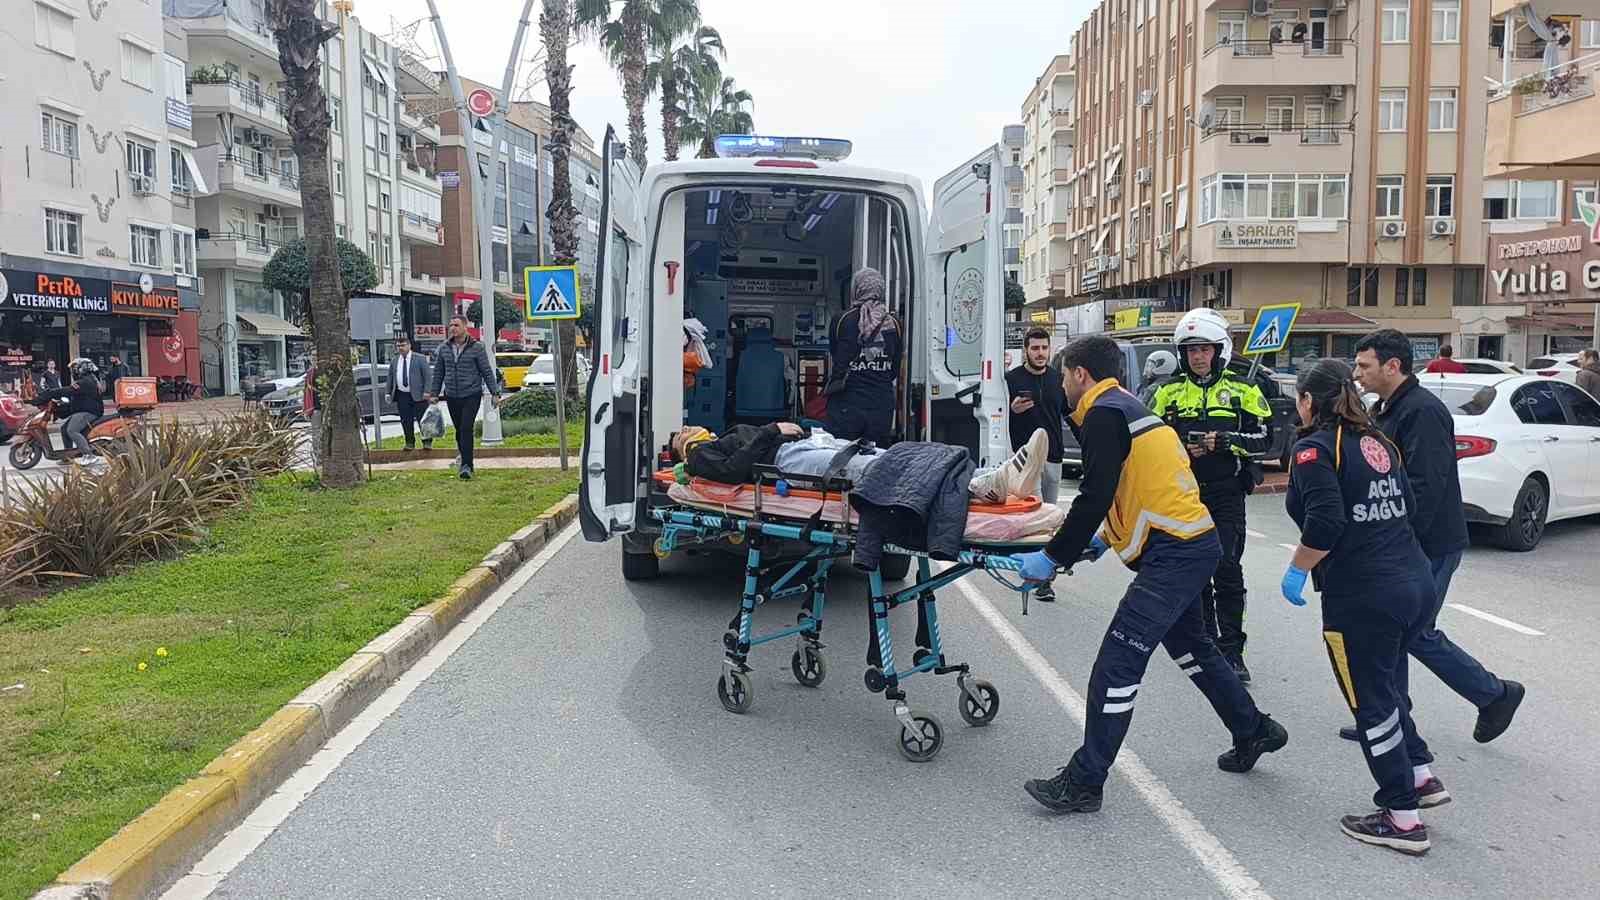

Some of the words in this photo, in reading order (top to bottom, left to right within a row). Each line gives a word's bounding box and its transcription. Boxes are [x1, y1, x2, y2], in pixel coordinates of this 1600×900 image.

[1237, 225, 1295, 237] SARILAR
[1491, 263, 1567, 296] Yulia
[112, 290, 139, 306] KIYI
[142, 292, 178, 309] MİDYE
[1368, 474, 1402, 499] ACİL
